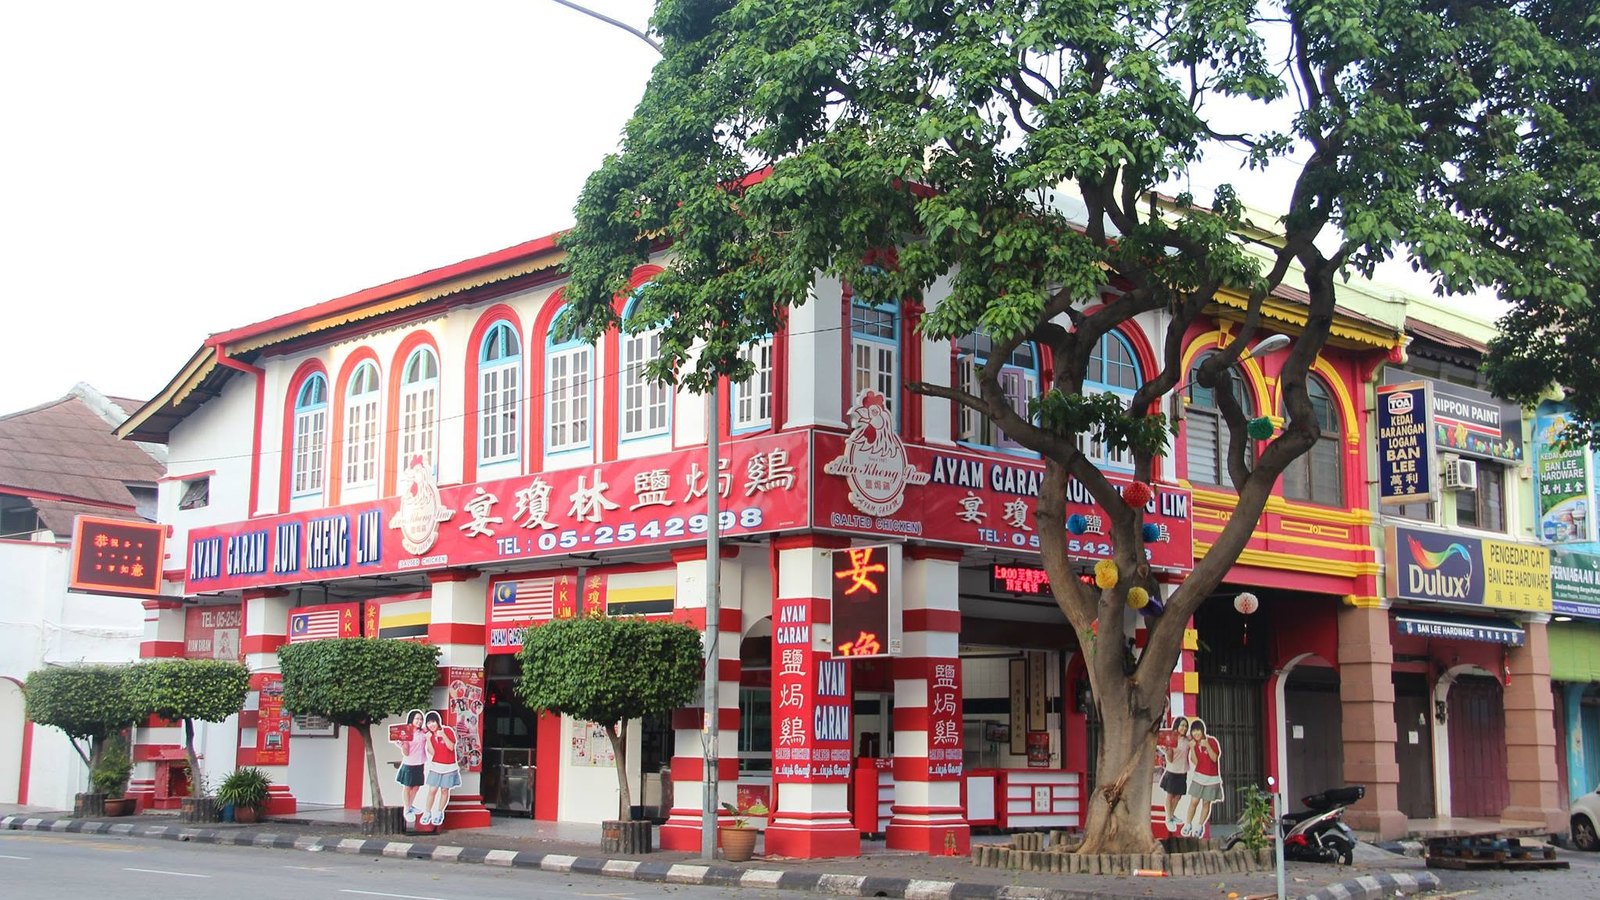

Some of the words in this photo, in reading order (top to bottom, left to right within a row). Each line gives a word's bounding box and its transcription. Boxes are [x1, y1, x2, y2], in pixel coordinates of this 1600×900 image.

[1390, 399, 1410, 409] TOA
[1433, 397, 1469, 418] NIPPON
[1471, 406, 1499, 425] PAINT
[1391, 414, 1413, 427] KEDAI
[1381, 423, 1424, 439] BARANGAN
[1389, 436, 1417, 449] LOGAM
[1386, 446, 1421, 461] BAN
[1391, 460, 1416, 473] LEE
[1541, 468, 1584, 482] HARDWARE
[1544, 461, 1560, 471] BAN
[1562, 460, 1577, 470] LEE
[933, 455, 984, 488] AYAM
[991, 464, 1044, 497] GARA
[1162, 492, 1187, 518] LIM
[537, 506, 763, 551] 05-2542998
[830, 511, 872, 528] (SALTED
[876, 519, 922, 536] CHICKEN)
[190, 538, 221, 581] AYAM
[227, 531, 267, 576] GARAM
[273, 523, 299, 573] AUN
[306, 515, 348, 569] KHENG
[356, 511, 380, 564] LIM
[1490, 544, 1530, 567] PENGEDAR
[1531, 550, 1545, 569] CAT
[1408, 563, 1466, 599] Dulux
[1488, 567, 1501, 585] BAN
[1502, 569, 1514, 586] LEE
[1515, 570, 1549, 590] HARDWARE
[1550, 565, 1594, 585] PERNIAGAAN
[780, 605, 806, 623] AYAM
[490, 627, 508, 647] AYAM
[777, 625, 809, 645] GARAM
[1417, 623, 1430, 633] BAN
[1430, 624, 1442, 634] LEE
[1442, 625, 1475, 638] HARDWARE
[818, 660, 846, 696] AYAM
[814, 704, 849, 741] GARAM
